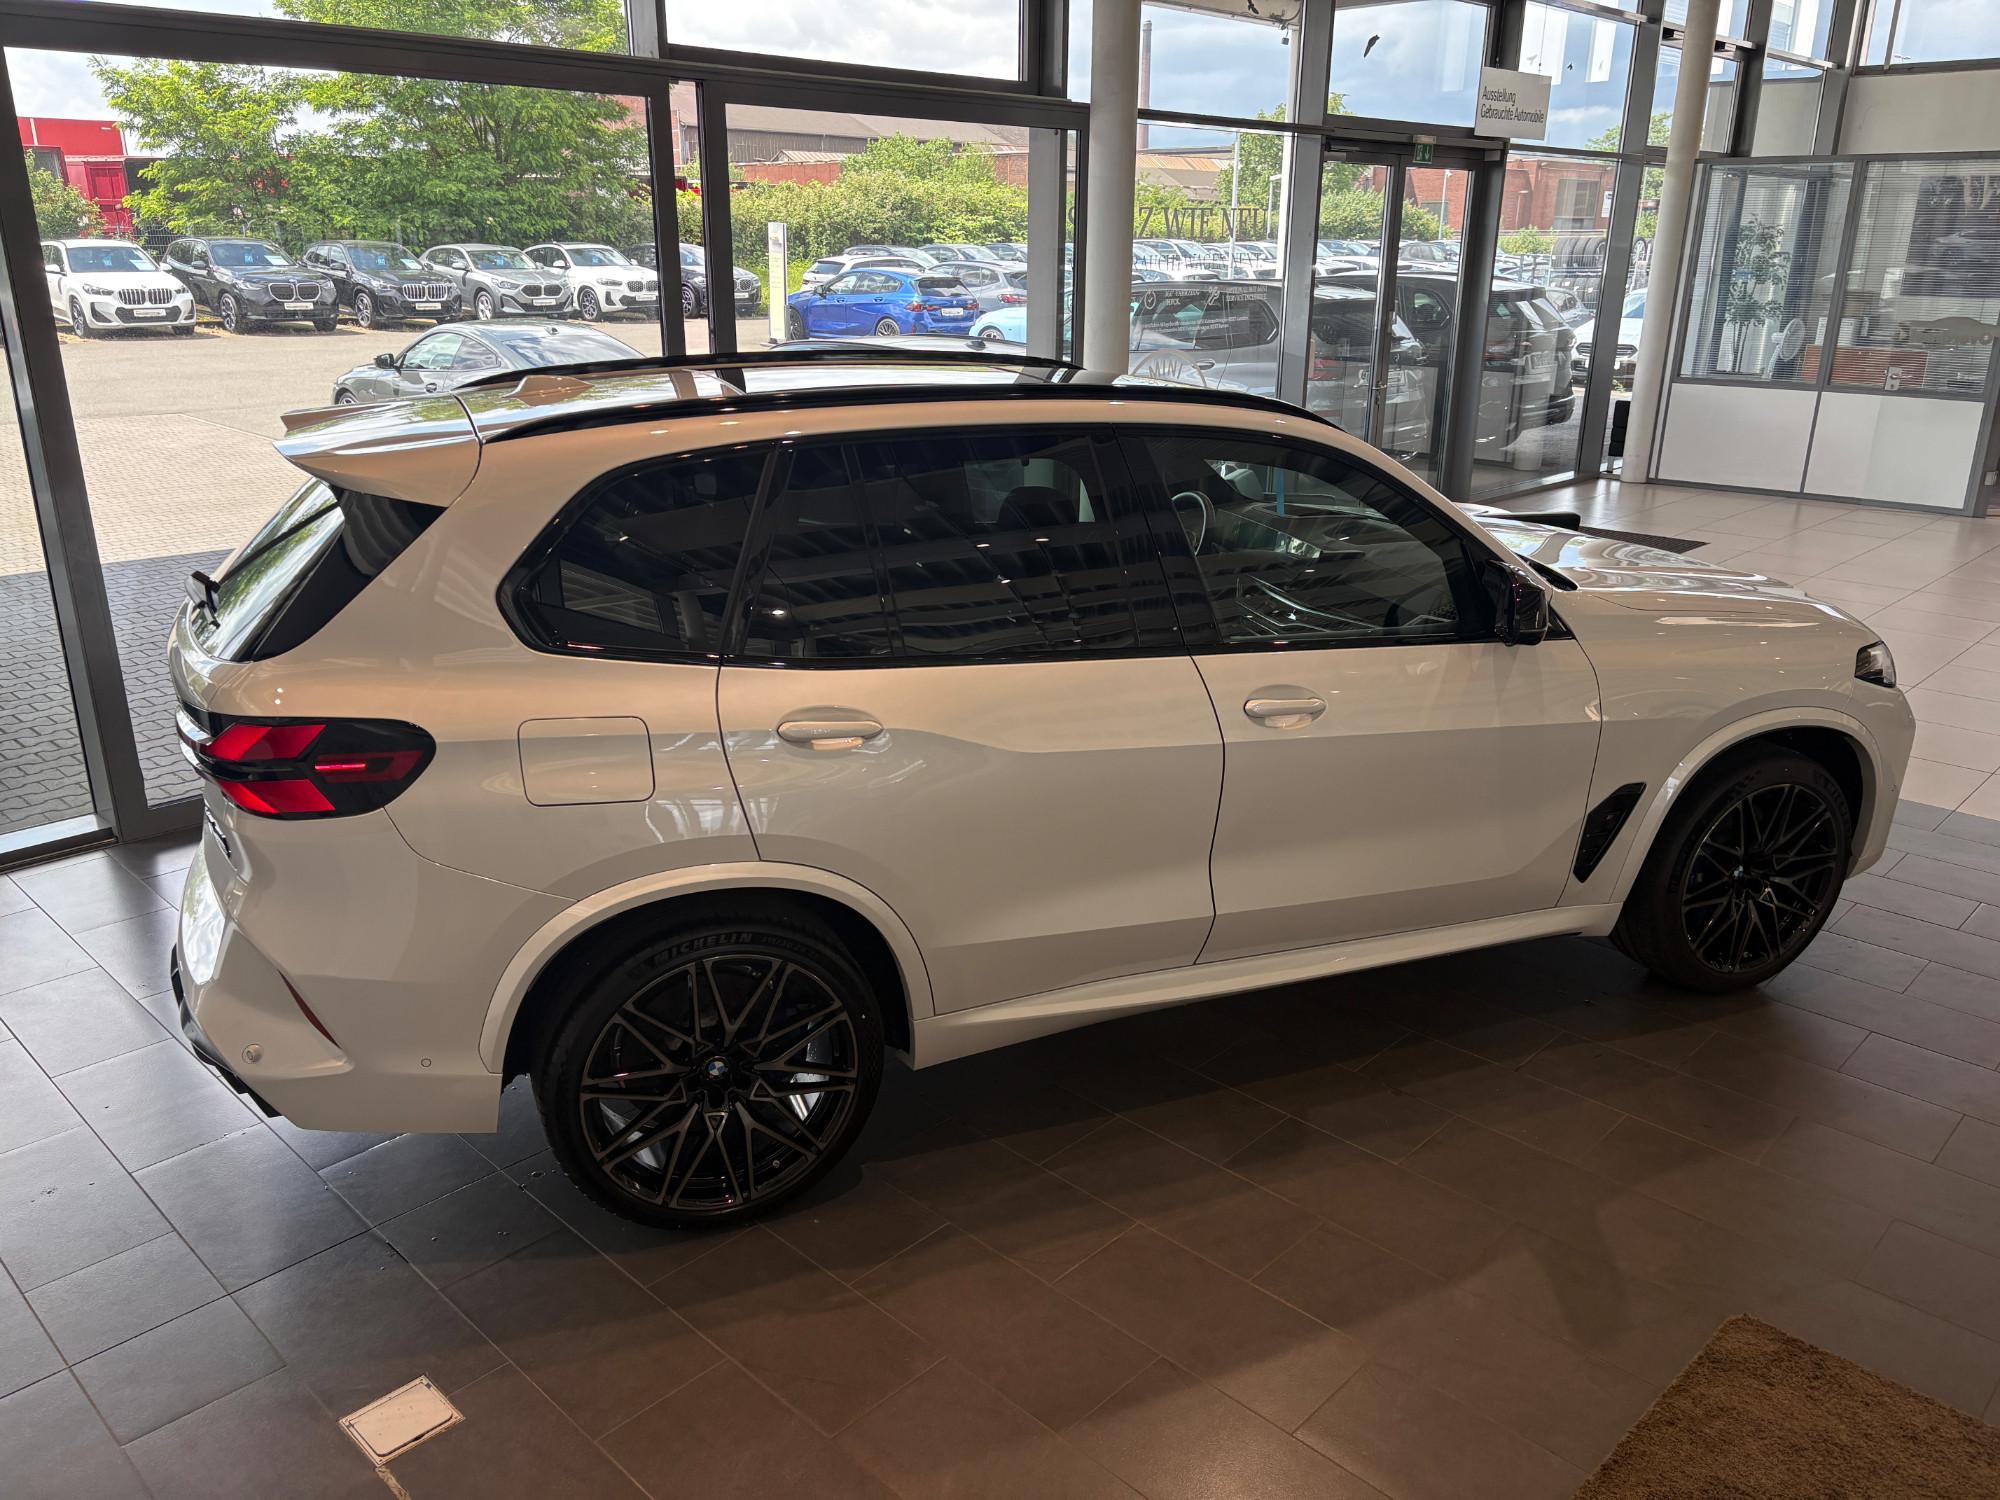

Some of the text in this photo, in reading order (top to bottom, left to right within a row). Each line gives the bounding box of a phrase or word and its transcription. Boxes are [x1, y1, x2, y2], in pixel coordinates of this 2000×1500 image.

[1482, 86, 1517, 106] Ausstellung
[1481, 104, 1545, 124] Gebrauchte Automobile
[1149, 360, 1183, 380] MINI
[653, 933, 754, 964] MICHELIN
